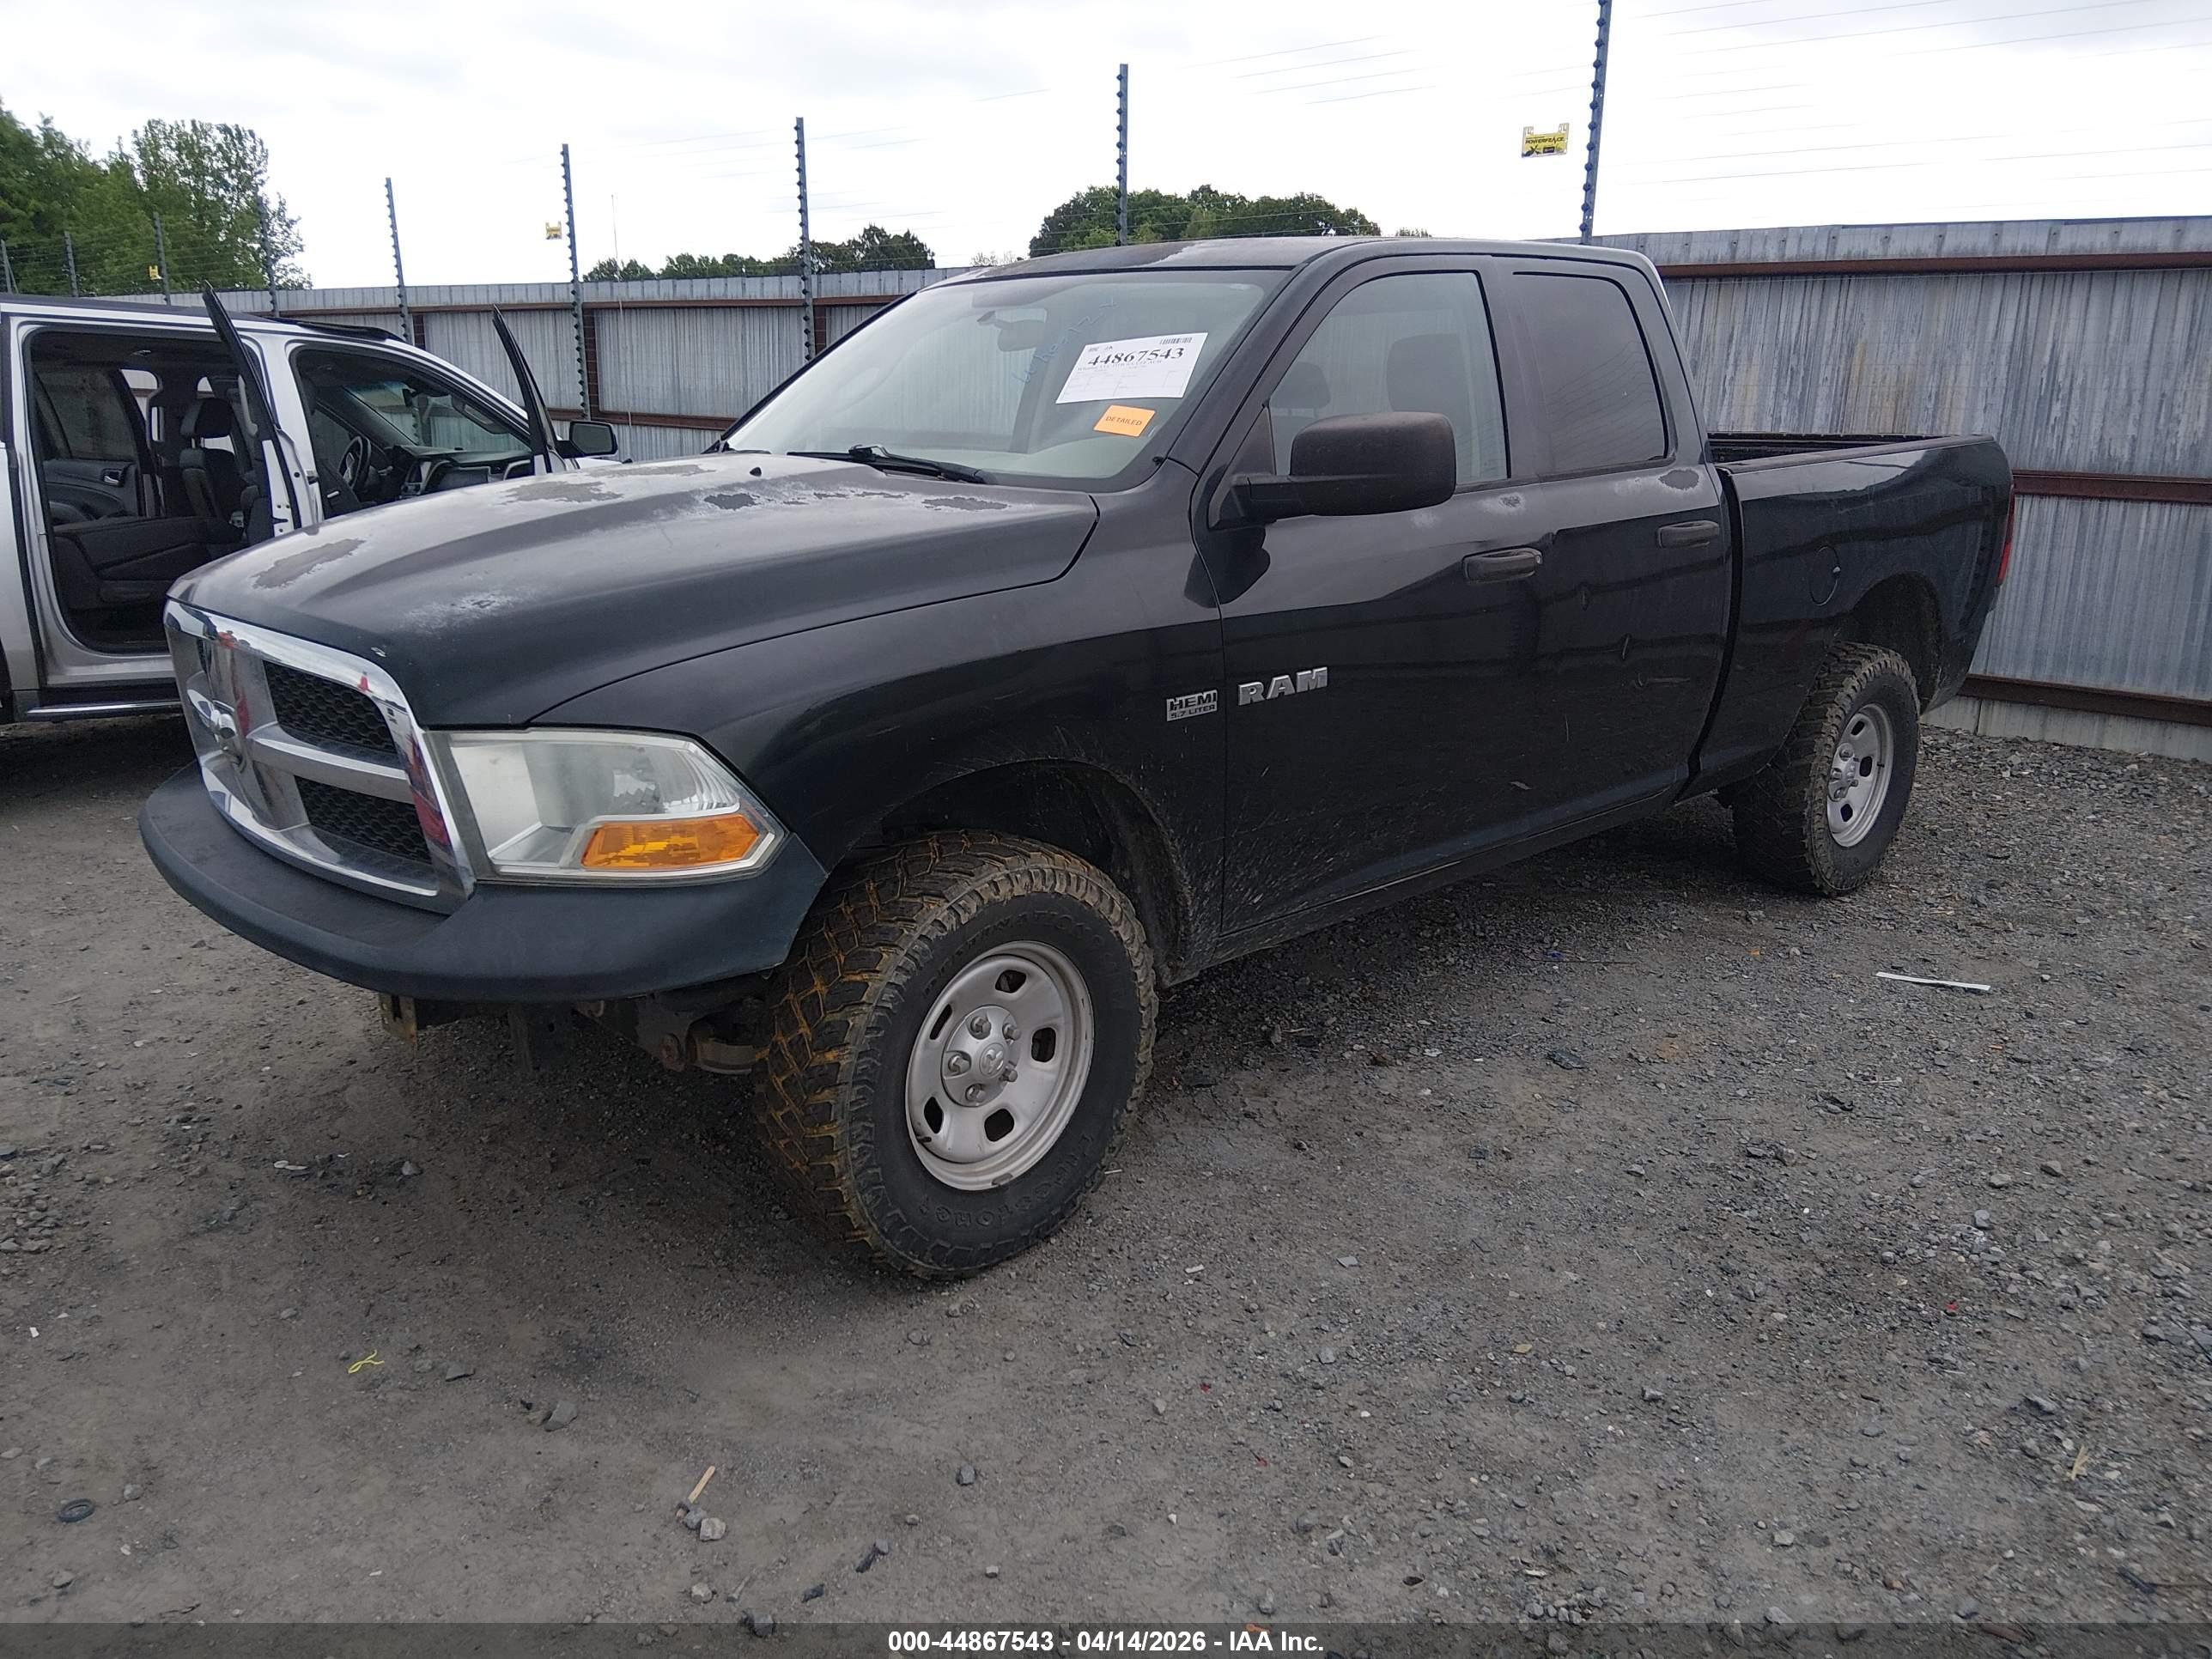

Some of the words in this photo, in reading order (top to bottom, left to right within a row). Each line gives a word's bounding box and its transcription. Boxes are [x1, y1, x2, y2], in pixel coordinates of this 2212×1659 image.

[1088, 347, 1185, 367] 44867543
[1105, 416, 1142, 427] DETAILED
[1238, 666, 1328, 706] RAM
[1170, 691, 1217, 711] HEMI
